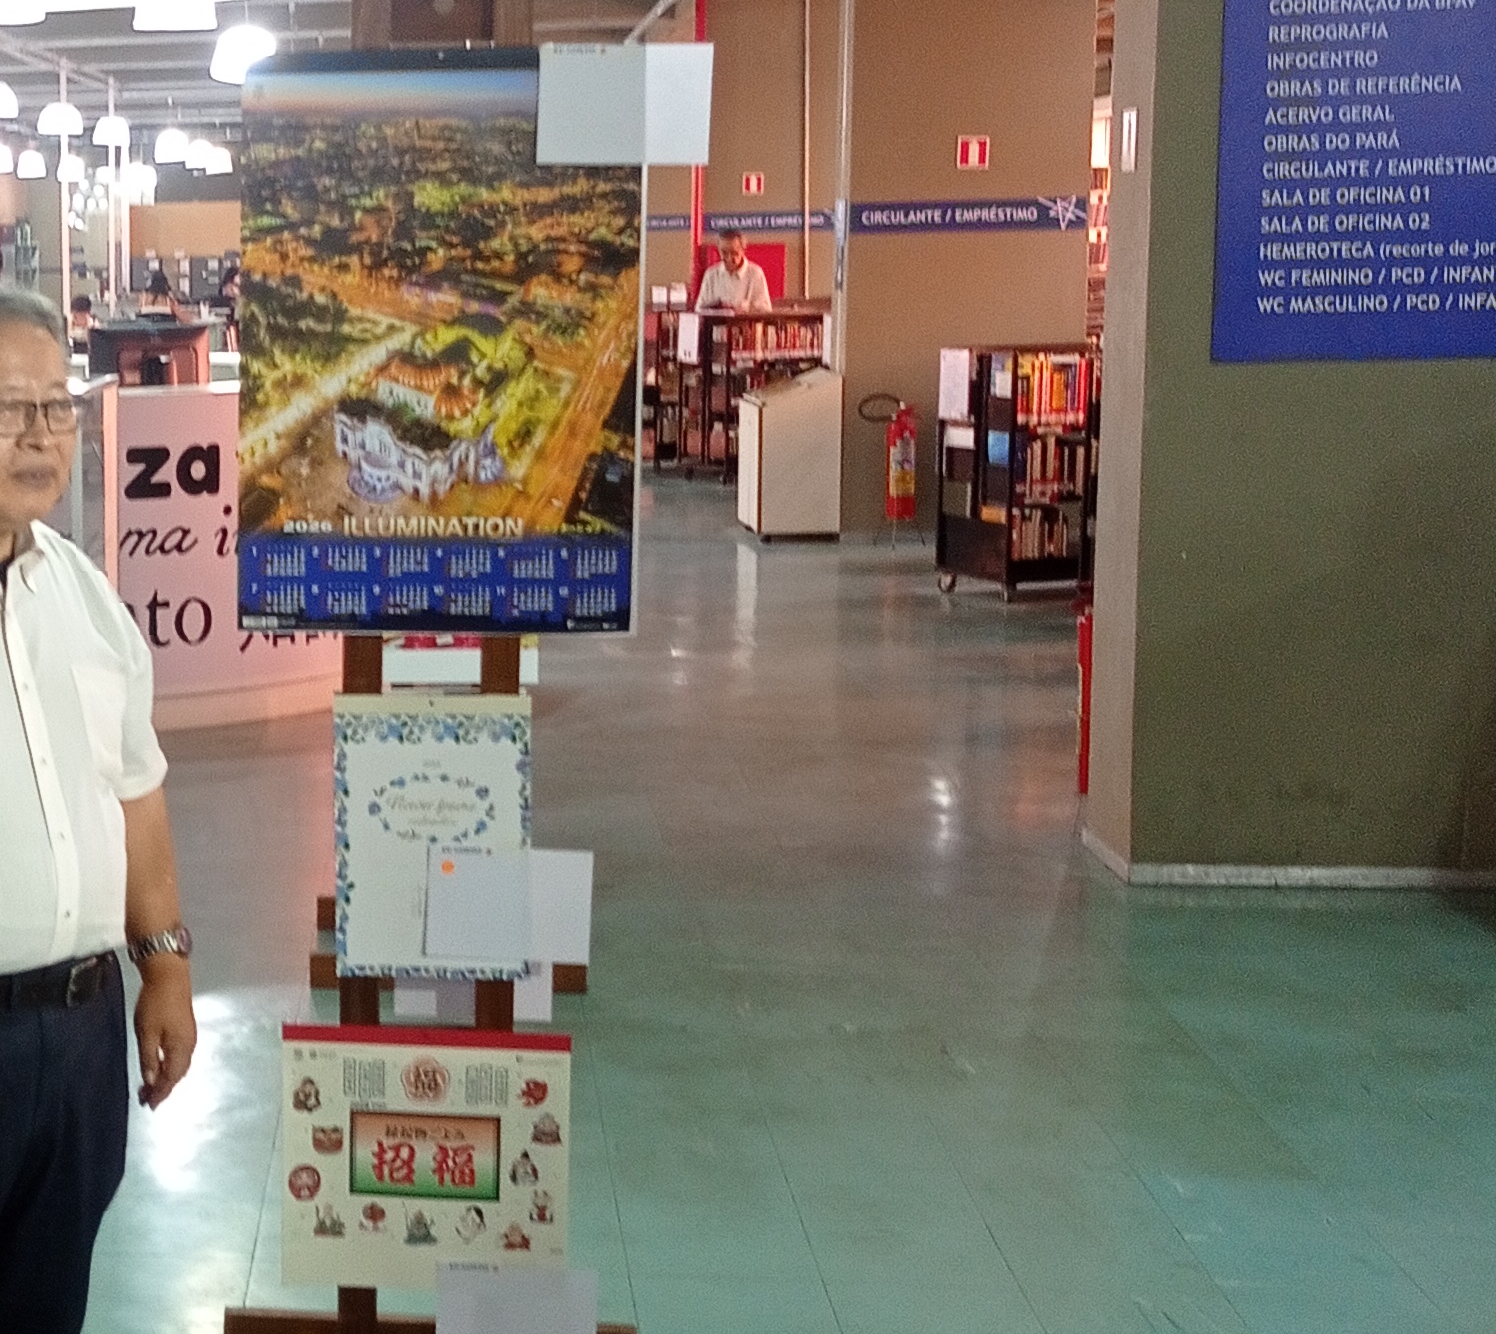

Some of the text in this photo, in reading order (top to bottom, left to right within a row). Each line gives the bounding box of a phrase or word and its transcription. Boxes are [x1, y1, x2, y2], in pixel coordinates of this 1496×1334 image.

[1268, 22, 1389, 43] REPROGRAFIA
[1267, 50, 1378, 71] INFOCENTRO
[1266, 72, 1462, 98] OBRAS DE REFERÊNCIA
[1264, 104, 1395, 126] ACERVO GERAL
[1263, 129, 1400, 152] OBRAS DO PARÁ
[1262, 153, 1496, 180] CIRCULANTE / EMPRÉSTIMO
[1261, 185, 1431, 207] SALA DE OFICINA 01
[861, 208, 942, 226] CIRCULANTE
[955, 204, 1038, 224] EMPRÉSTIMO
[1260, 212, 1431, 234] SALA DE OFICINA 02
[1259, 241, 1374, 261] HEMEROTECA
[1379, 241, 1444, 262] (recorte
[1449, 240, 1469, 257] de
[1258, 269, 1285, 288] WC
[1291, 267, 1373, 287] FEMININO
[1391, 266, 1425, 285] PCD
[1256, 296, 1284, 314] WC
[1289, 294, 1388, 315] MASCULINO
[1406, 293, 1440, 312] PCD
[124, 443, 220, 499] za
[343, 515, 524, 537] ILLUMINATION
[125, 590, 212, 648] to
